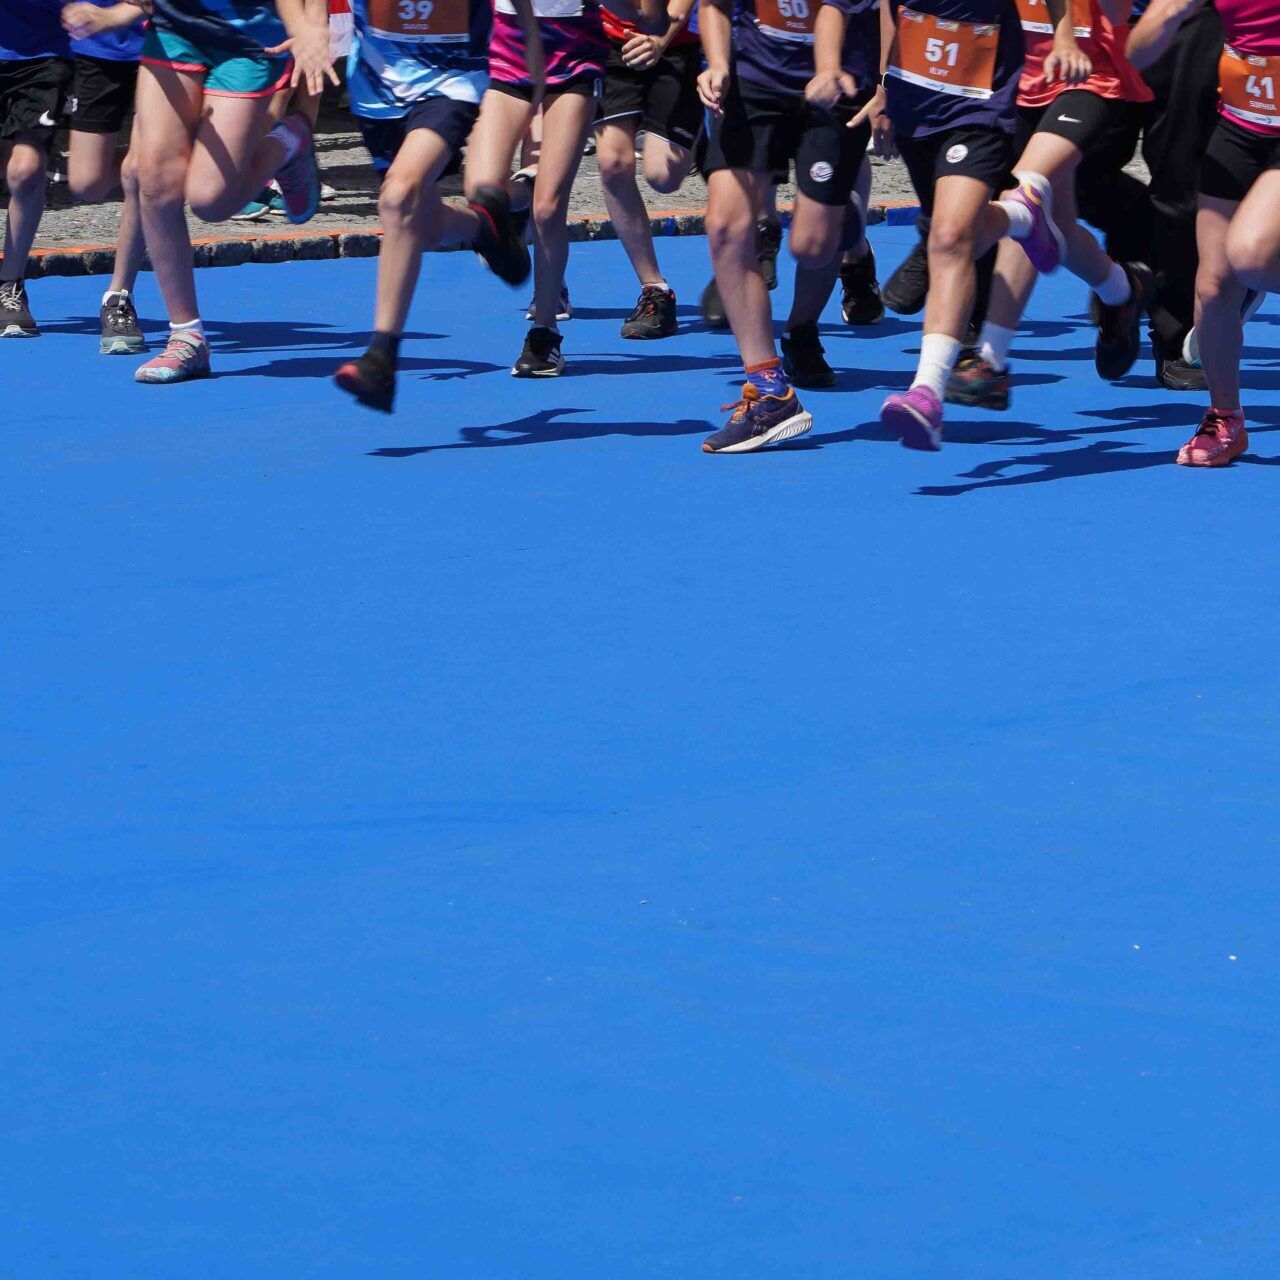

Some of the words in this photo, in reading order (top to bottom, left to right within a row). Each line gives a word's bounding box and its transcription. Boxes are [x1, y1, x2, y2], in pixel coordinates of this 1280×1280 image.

[398, 0, 434, 20] 39
[923, 37, 960, 66] 51
[1244, 74, 1275, 100] 41
